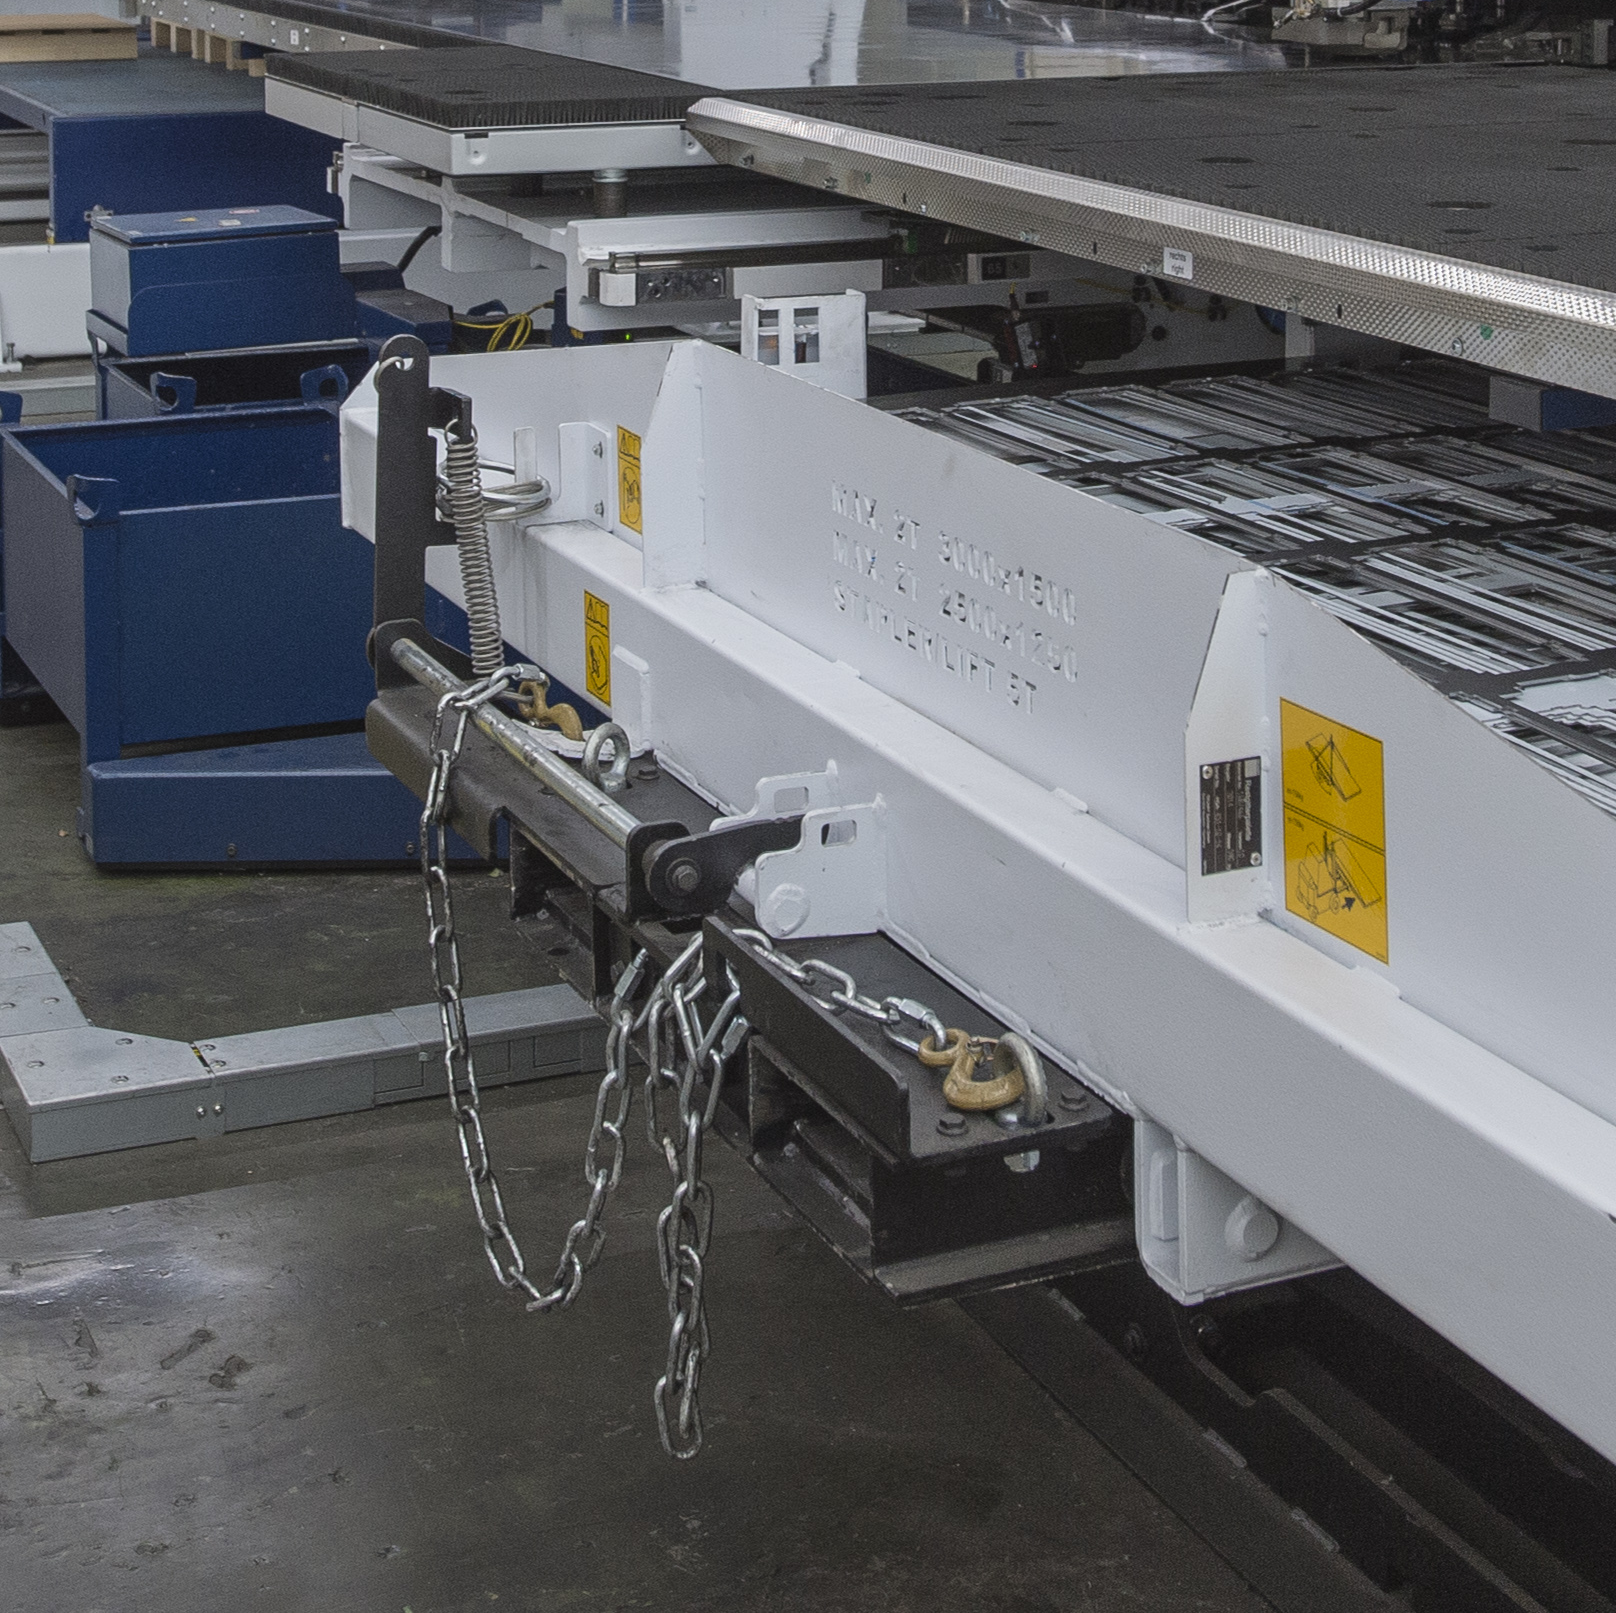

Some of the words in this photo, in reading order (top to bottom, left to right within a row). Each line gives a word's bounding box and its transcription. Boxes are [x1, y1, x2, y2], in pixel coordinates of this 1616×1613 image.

[893, 509, 921, 551] 2T
[937, 530, 1078, 627] 3000x1500
[894, 560, 920, 603] 2T
[938, 583, 1079, 683] 2500x1250
[1006, 671, 1037, 715] 5T
